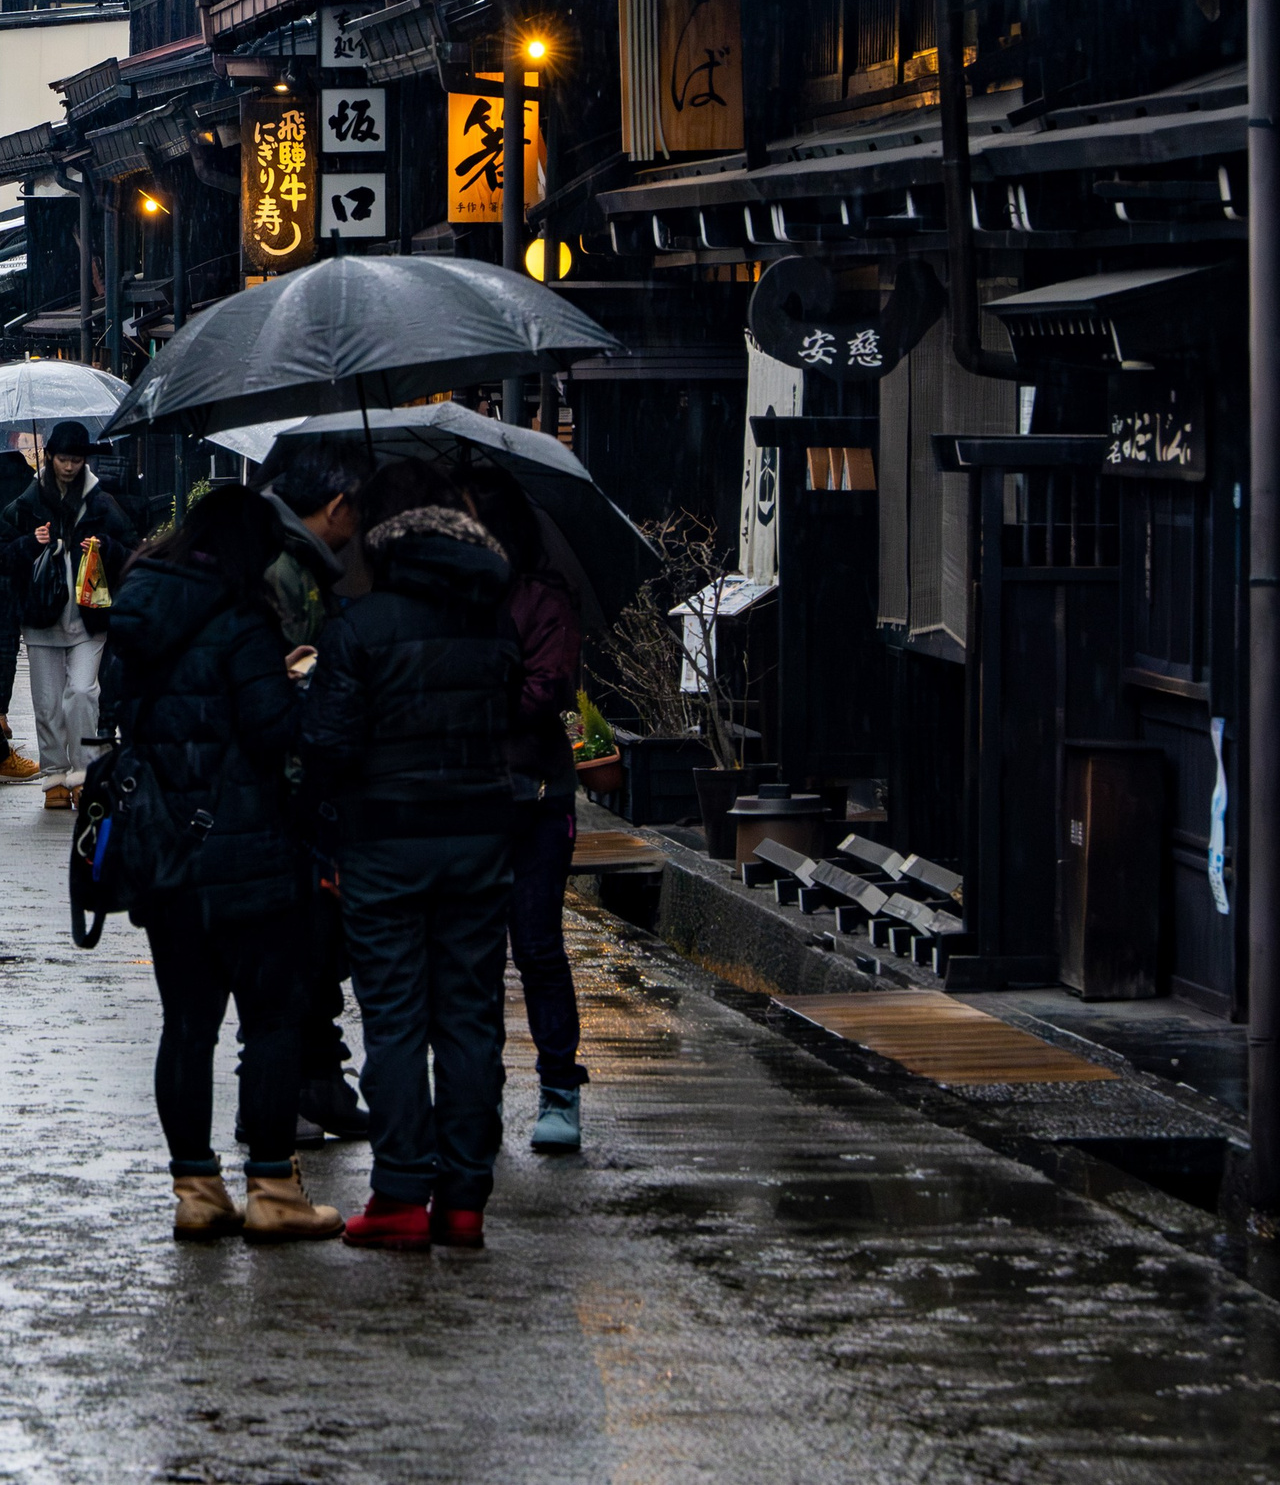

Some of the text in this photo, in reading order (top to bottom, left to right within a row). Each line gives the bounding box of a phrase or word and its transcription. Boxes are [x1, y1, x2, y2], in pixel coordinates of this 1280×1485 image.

[277, 110, 307, 212] 飛騨牛
[328, 99, 380, 222] 坂口
